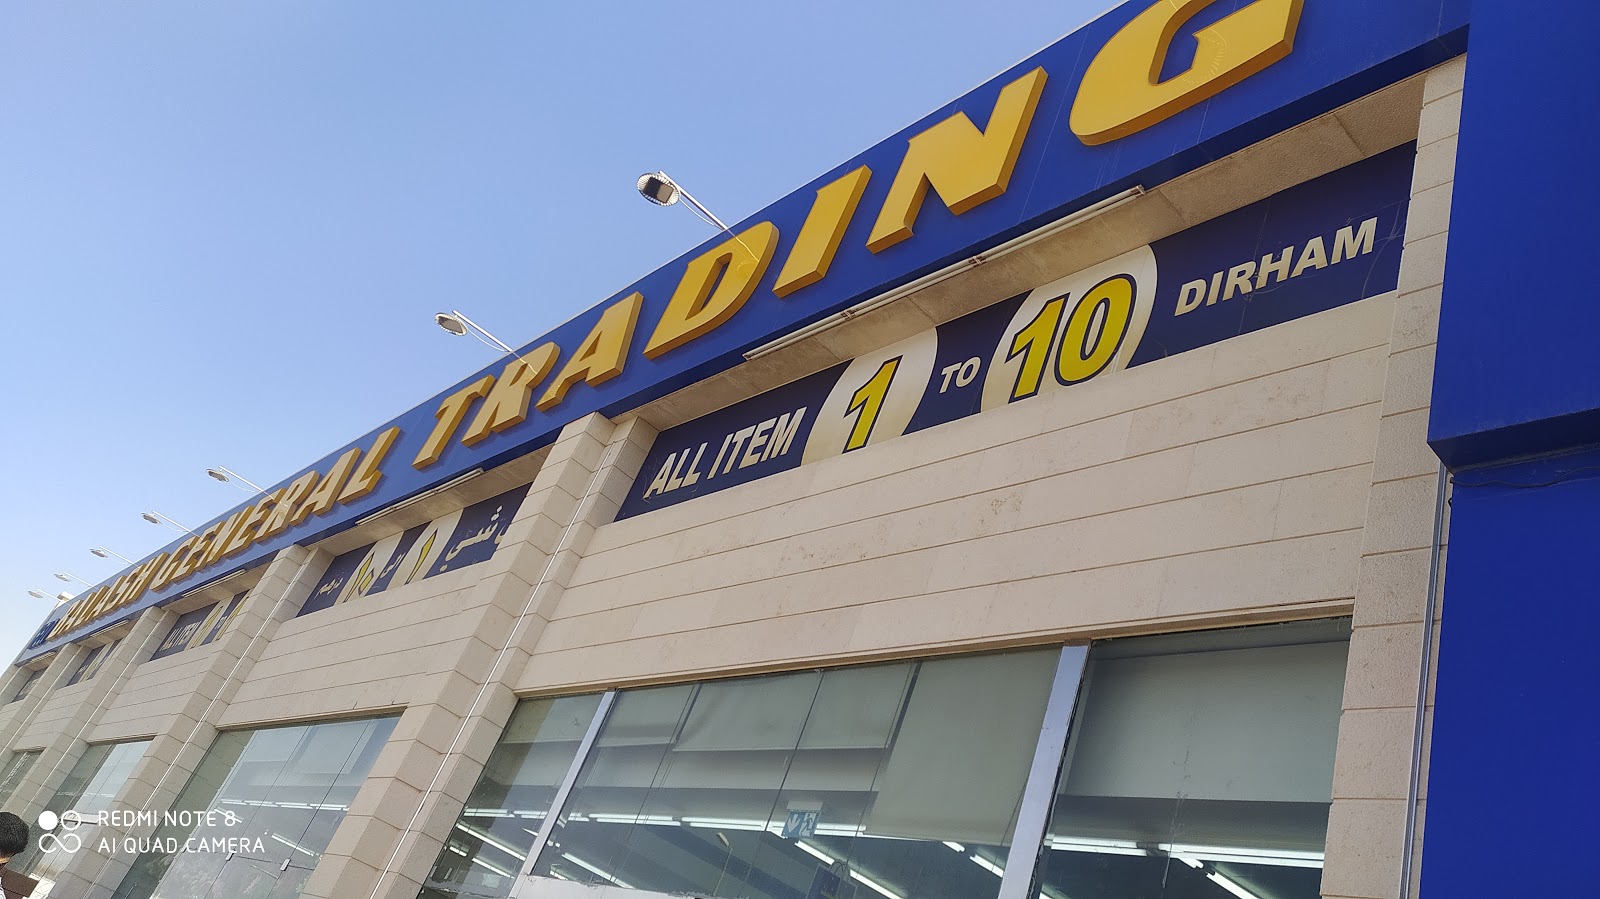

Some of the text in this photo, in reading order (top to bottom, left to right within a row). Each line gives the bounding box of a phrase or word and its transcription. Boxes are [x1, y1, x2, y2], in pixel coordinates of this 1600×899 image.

[46, 0, 1304, 640] BALASH GENERAL TRADING
[642, 217, 1378, 499] ALL ITEM 1 TO 10 DIRHAM
